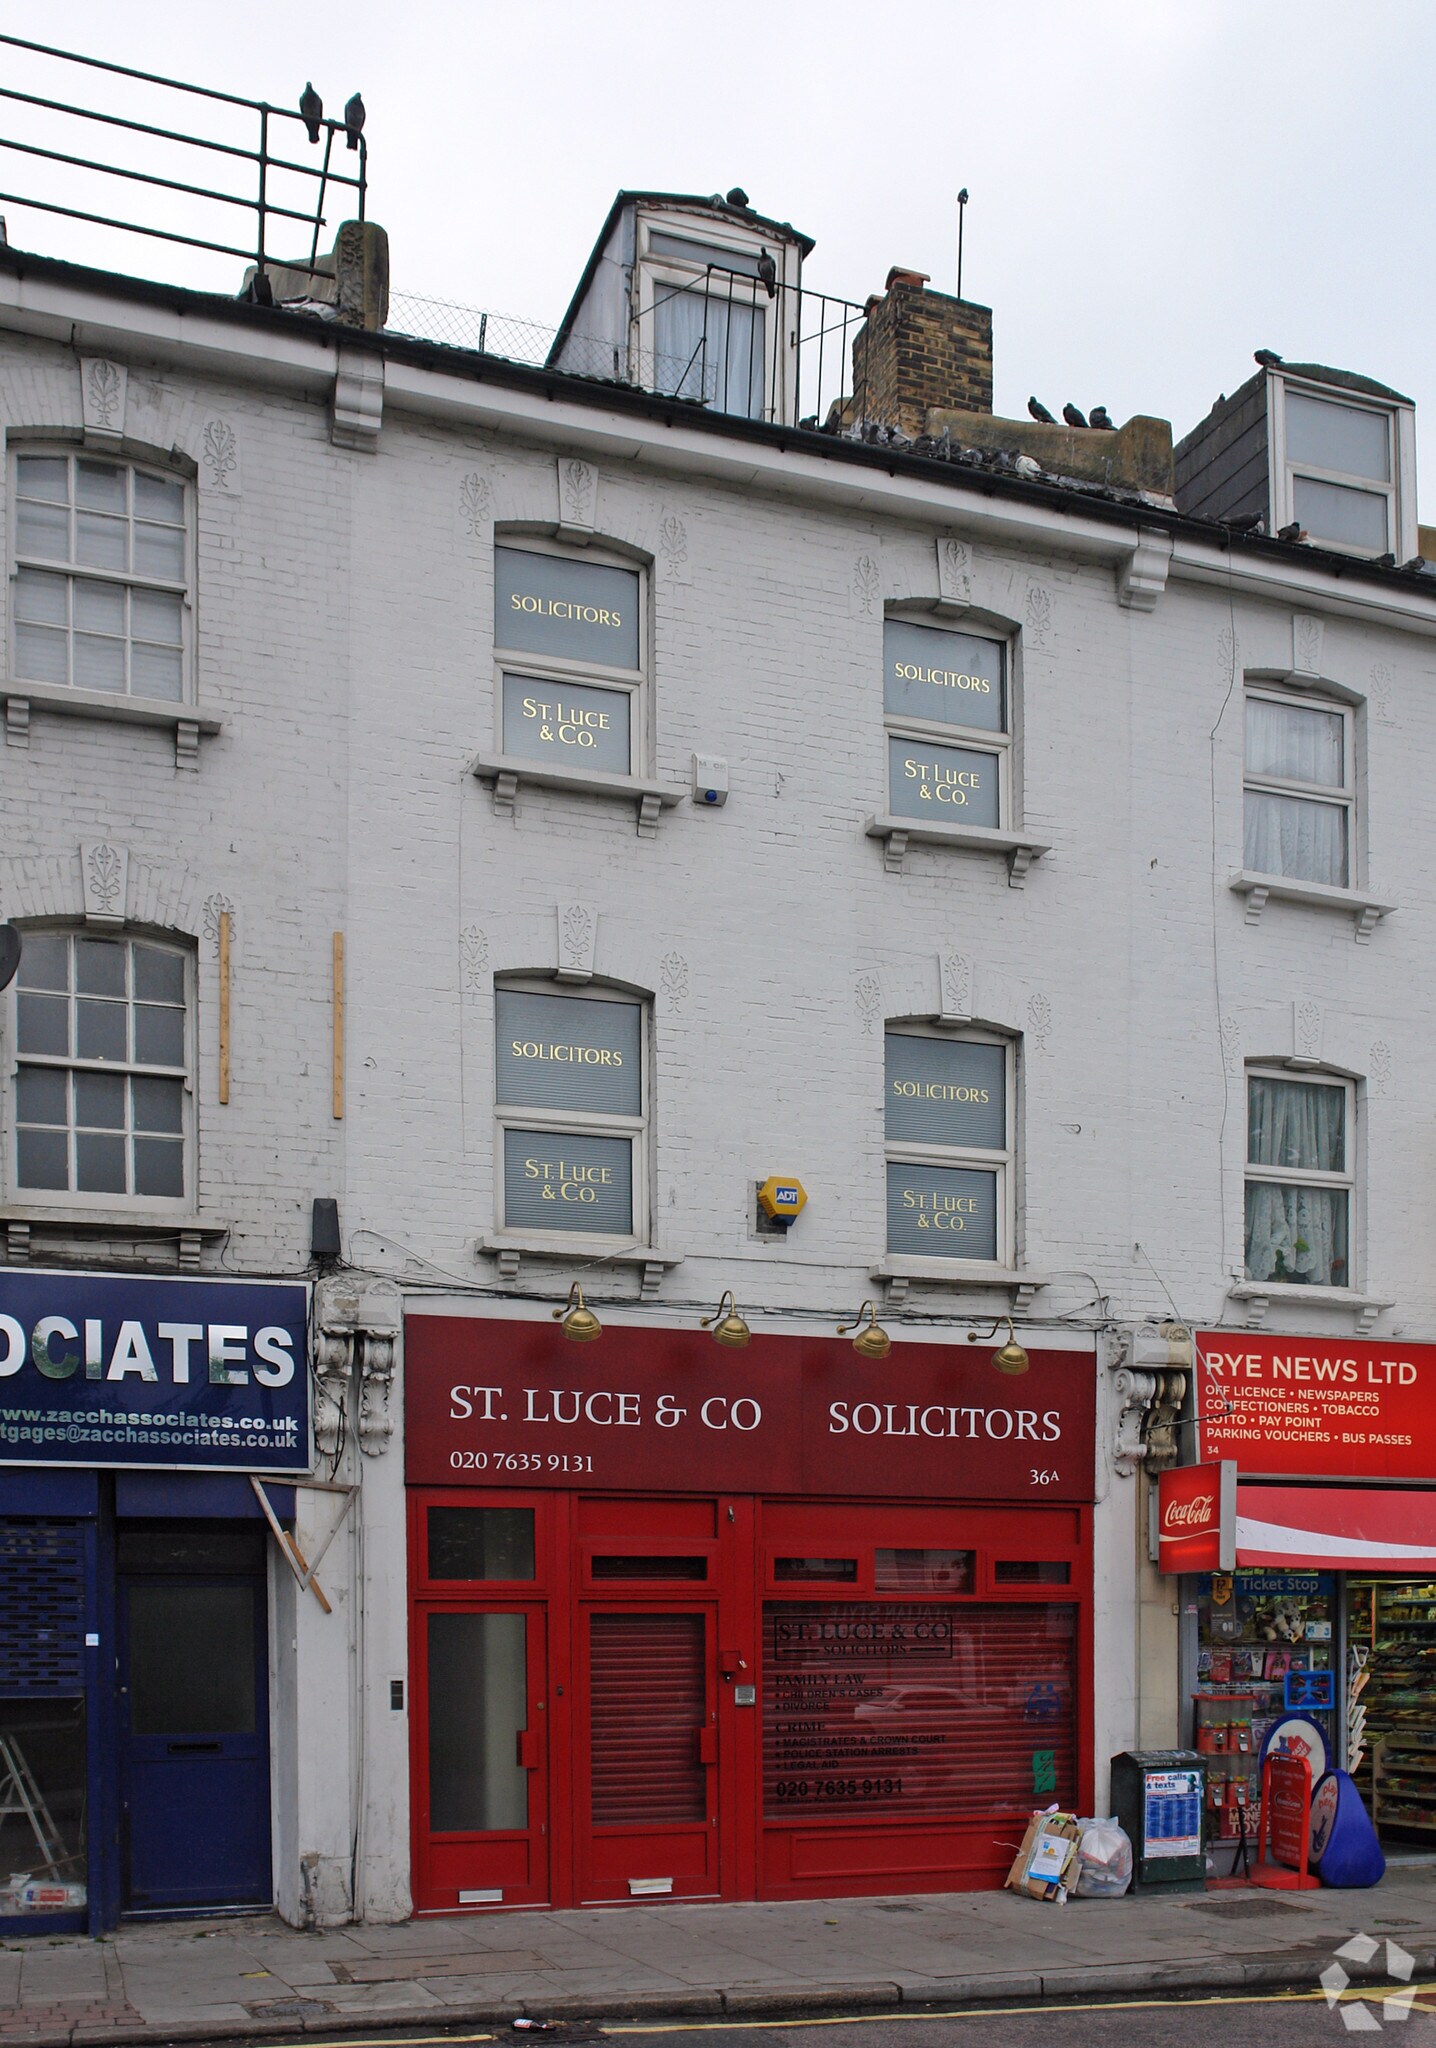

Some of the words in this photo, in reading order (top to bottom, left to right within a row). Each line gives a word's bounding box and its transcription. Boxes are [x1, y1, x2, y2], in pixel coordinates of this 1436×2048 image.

[511, 594, 621, 627] SOLICITORS
[895, 662, 990, 694] SOLICITORS
[512, 1040, 623, 1067] SOLICITORS
[893, 1080, 989, 1103] SOLICITORS
[777, 1190, 797, 1201] ADT
[1206, 1352, 1262, 1377] RYE
[1273, 1356, 1358, 1383] NEWS
[1368, 1361, 1417, 1385] LTD
[1206, 1385, 1230, 1396] OFF
[1234, 1386, 1286, 1399] LICENCE
[1298, 1389, 1379, 1403] NEWSPAPERS
[450, 1385, 508, 1420] ST.
[522, 1388, 641, 1426] LUCE
[655, 1395, 687, 1428] &
[700, 1397, 762, 1431] CO
[1322, 1404, 1379, 1416] TOBACCO
[0, 1409, 298, 1431] ww.zacchassociates.co.uk
[829, 1401, 1061, 1442] SOLICITORS
[1206, 1413, 1246, 1425] LOTTO
[1259, 1416, 1281, 1426] PAY
[1285, 1417, 1322, 1428] POINT
[1206, 1428, 1261, 1440] PARKING
[1265, 1430, 1331, 1442] VOUCHERS
[1343, 1432, 1366, 1443] BUS
[1369, 1434, 1412, 1445] PASSES
[1207, 1446, 1219, 1454] 34
[450, 1451, 487, 1469] 020
[493, 1452, 542, 1471] 7635
[547, 1454, 594, 1473] 9131
[1030, 1469, 1060, 1485] 36A
[1241, 1578, 1284, 1591] Ticket
[1287, 1578, 1319, 1592] Stop
[778, 1622, 812, 1641] ST.
[819, 1622, 885, 1640] LUCE
[891, 1622, 908, 1639] &
[914, 1621, 949, 1639] CO
[823, 1643, 907, 1656] SOLICITORS
[775, 1674, 829, 1686] FAMILY
[834, 1673, 865, 1685] LAW
[783, 1689, 846, 1699] CHILDREN'S
[848, 1688, 883, 1698] CASES
[783, 1702, 830, 1711] DIVORCE
[775, 1721, 826, 1733] CRIME
[783, 1737, 857, 1747] MAGISTRATES
[860, 1736, 867, 1745] &
[869, 1735, 909, 1745] CROWN
[911, 1734, 946, 1744] COURT
[783, 1749, 822, 1759] POLICE
[824, 1748, 868, 1758] STATION
[870, 1747, 919, 1756] ARRESTS
[783, 1761, 818, 1770] LEGAL
[821, 1760, 839, 1769] AID
[1146, 1774, 1165, 1782] Free
[1167, 1773, 1187, 1781] calls
[1154, 1781, 1176, 1789] texts
[775, 1781, 808, 1797] 020
[814, 1780, 857, 1796] 7635
[862, 1778, 903, 1793] 9131
[1322, 1781, 1337, 1797] play
